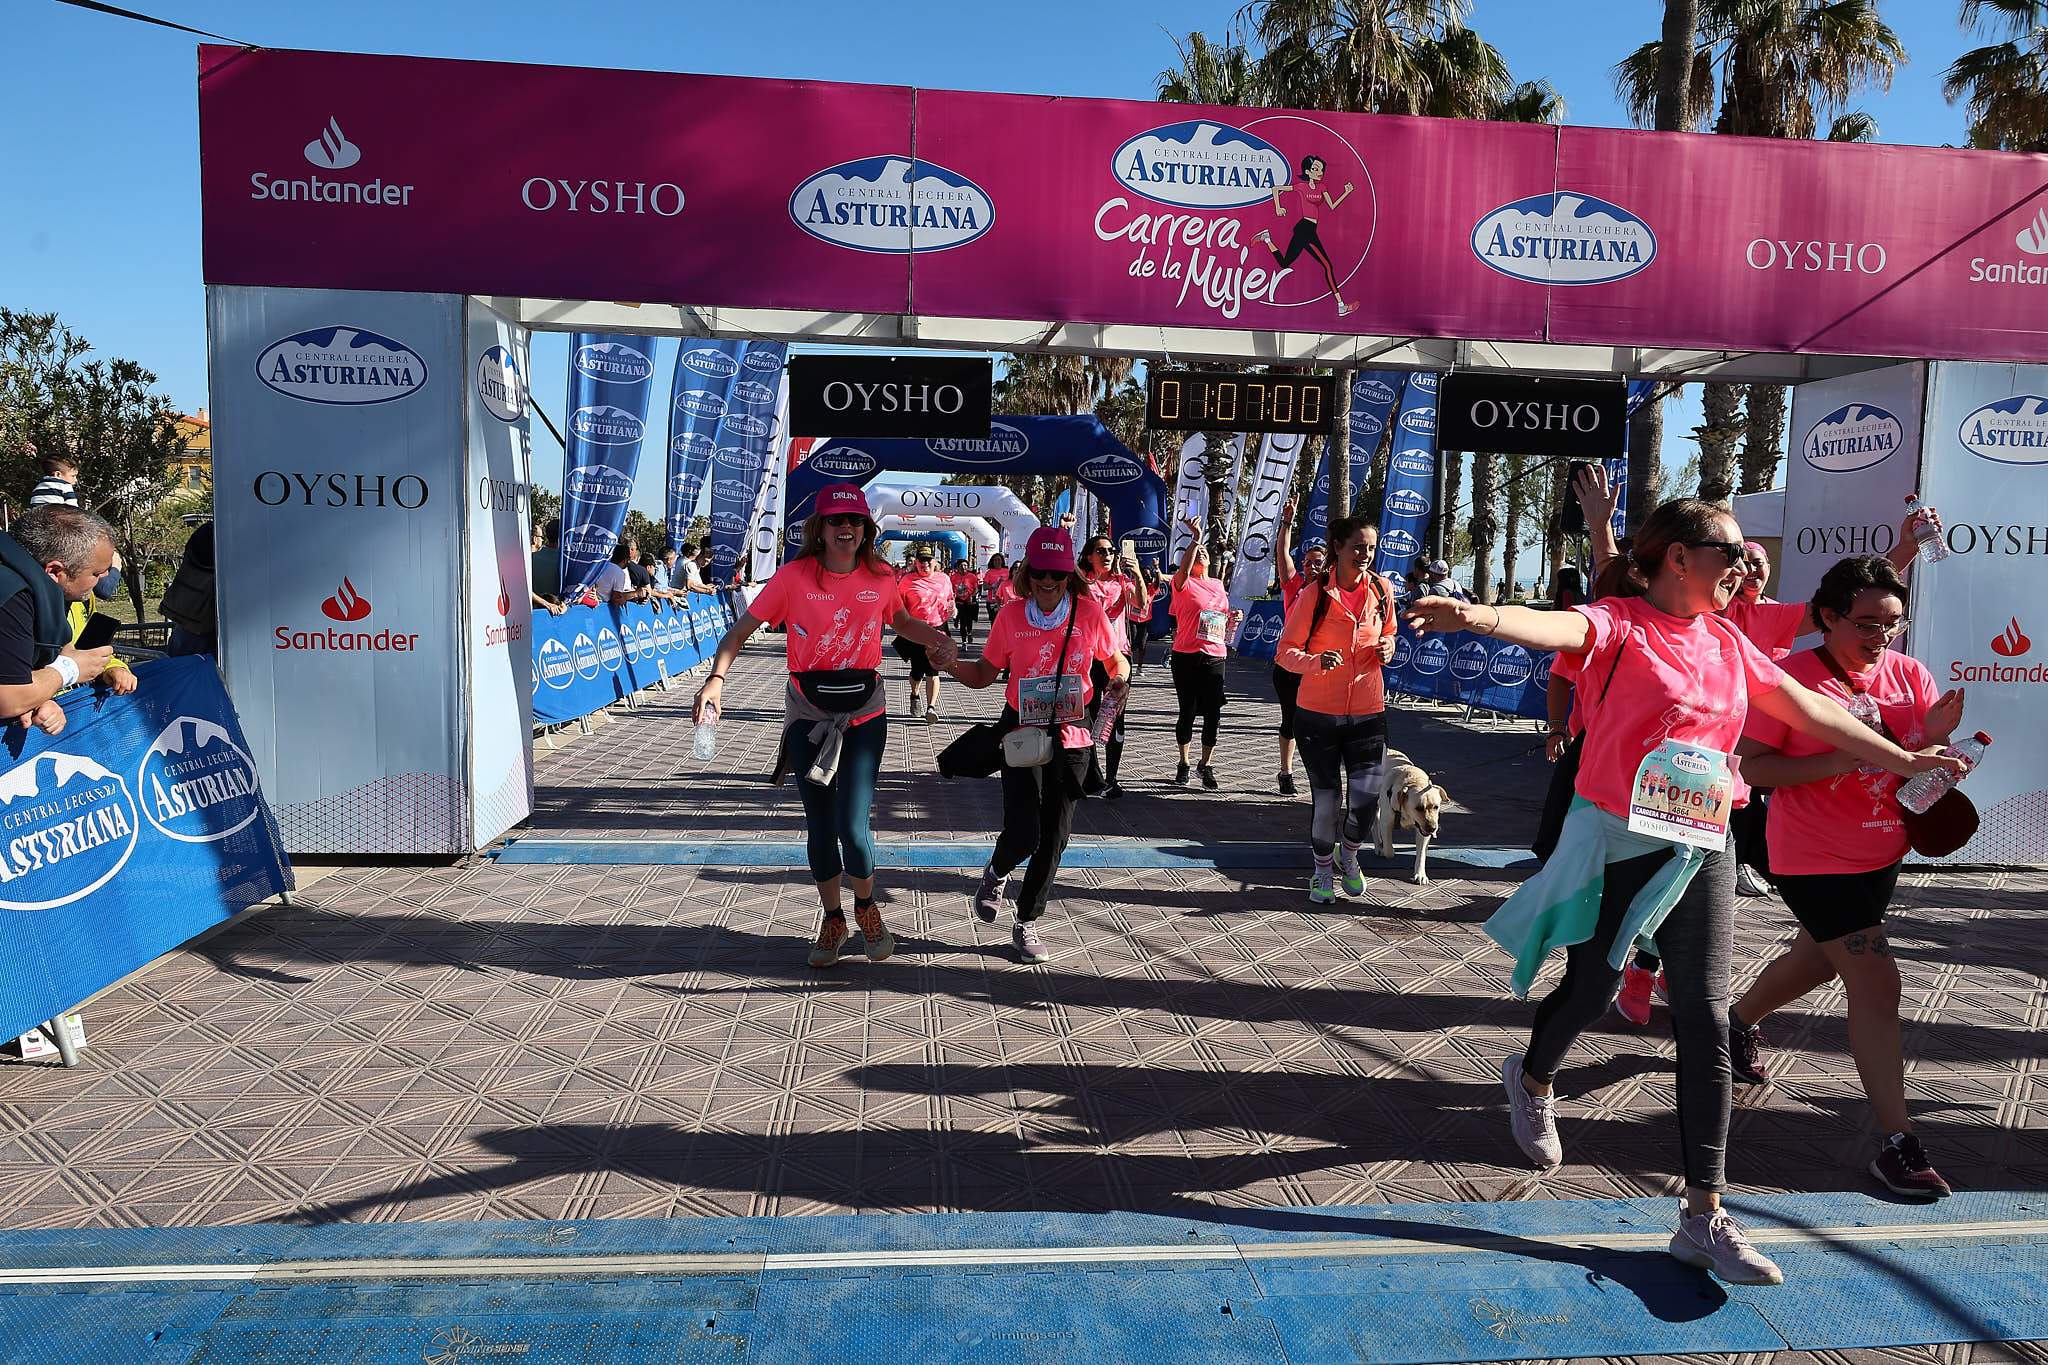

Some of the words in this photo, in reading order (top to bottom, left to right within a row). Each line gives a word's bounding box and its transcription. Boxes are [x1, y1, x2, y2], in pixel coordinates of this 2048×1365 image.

[1125, 148, 1275, 189] ASTURIANA
[1154, 148, 1210, 160] CENTRAL
[1215, 151, 1273, 163] LECHERA
[251, 173, 414, 206] Santander
[522, 177, 686, 216] OYSHO
[837, 187, 901, 199] CENTRAL
[805, 188, 979, 230] ASTURIANA
[1094, 197, 1241, 249] Carrera
[1515, 222, 1573, 233] CENTRAL
[1579, 225, 1638, 236] LECHERA
[1485, 222, 1642, 263] ASTURIANA
[1746, 238, 1887, 274] OYSHO
[1128, 246, 1156, 279] de
[1162, 247, 1181, 280] la
[1175, 246, 1294, 319] Mujer
[269, 353, 415, 388] ASTURIANA
[295, 352, 350, 363] CENTRAL
[355, 354, 410, 364] LECHERA
[577, 351, 646, 376] ASTURIANA
[822, 381, 964, 415] OYSHO
[573, 415, 640, 438] ASTURIANA
[1471, 399, 1600, 433] OYSHO
[1823, 426, 1854, 437] CENTRAL
[1856, 421, 1892, 433] LECHERA
[1990, 417, 2031, 428] CENTRAL
[1808, 432, 1894, 459] ASTURIANA
[815, 457, 871, 471] ASTURIANA
[1083, 466, 1139, 478] ASTURIANA
[253, 471, 429, 509] OYSHO
[480, 476, 525, 514] OYSHO
[568, 476, 629, 498] ASTURIANA
[901, 490, 981, 509] OYSHO
[1797, 524, 1893, 555] OYSHO
[275, 626, 419, 651] Santander
[164, 758, 206, 778] CENTRAL
[207, 750, 239, 766] LECHE
[4, 801, 62, 830] CENTRAL
[65, 783, 116, 811] LECHERA
[1667, 785, 1704, 807] 016
[1635, 806, 1660, 818] CARRERA
[1667, 814, 1675, 822] LA
[1676, 816, 1694, 826] MUJER
[1697, 820, 1720, 832] VALENCIA
[1639, 820, 1669, 833] OYSHO
